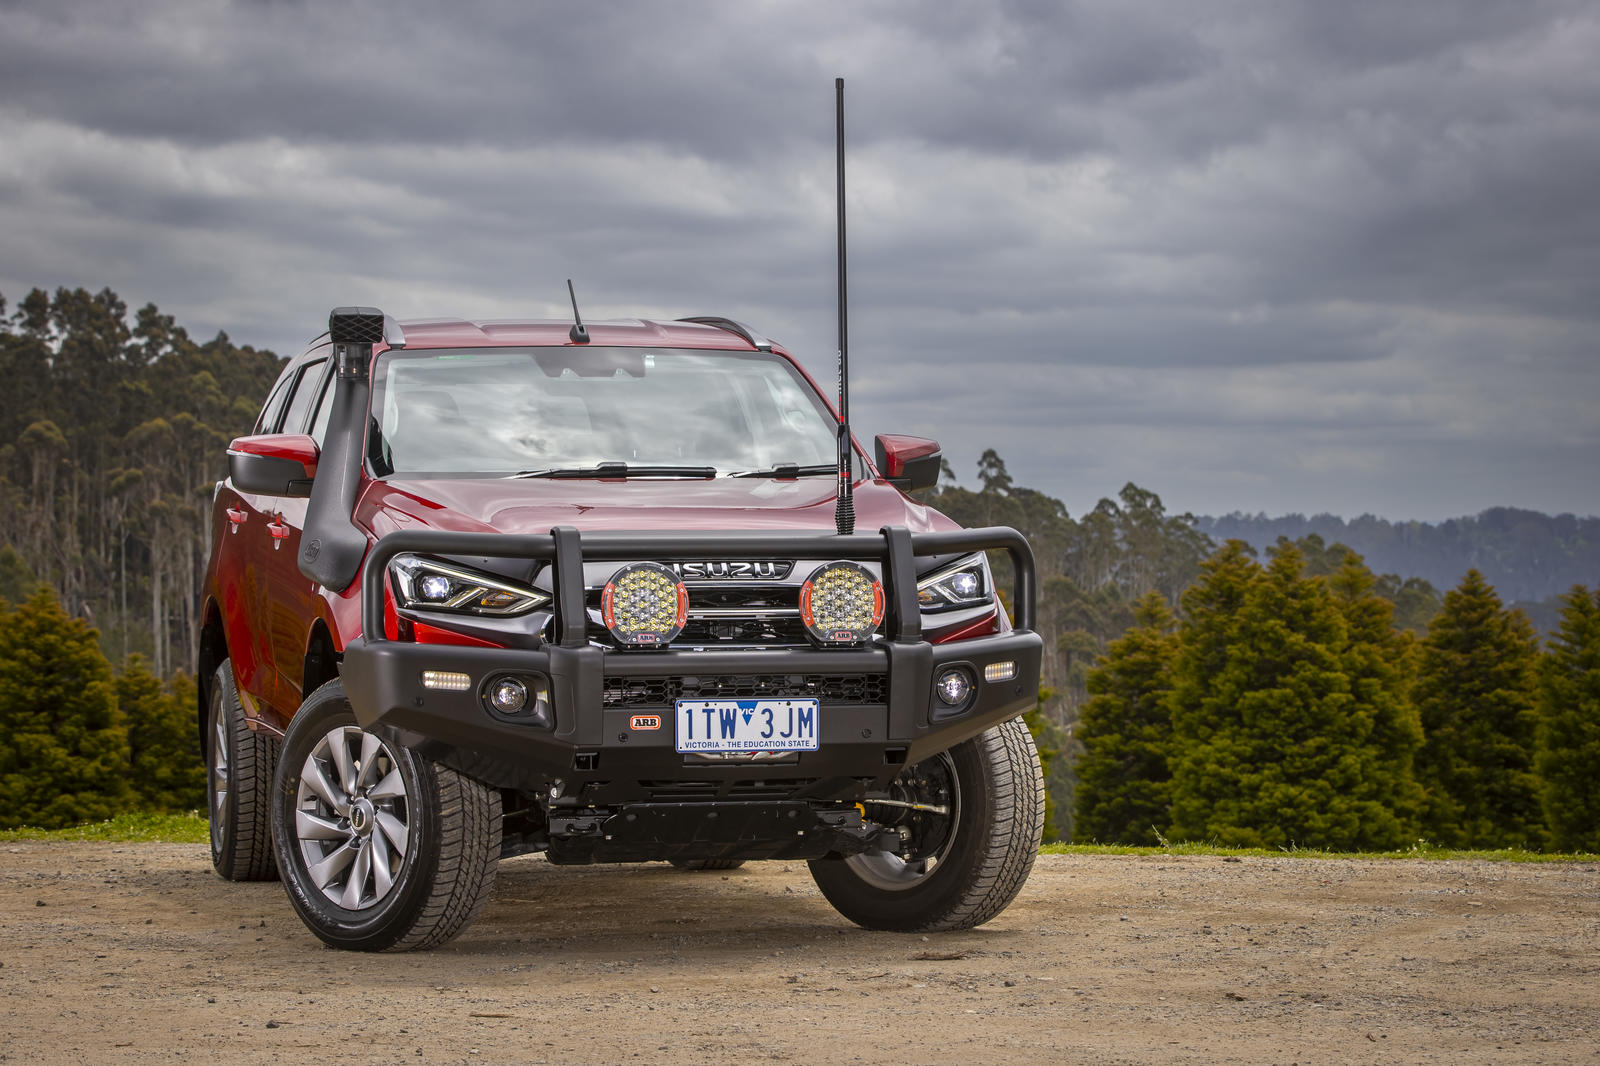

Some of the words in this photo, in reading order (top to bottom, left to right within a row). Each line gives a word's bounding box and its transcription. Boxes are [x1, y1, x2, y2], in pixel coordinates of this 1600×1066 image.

[672, 562, 776, 579] ISUZU
[634, 718, 657, 727] ARB
[685, 708, 737, 739] 1TW
[760, 707, 813, 739] 3JM
[743, 740, 786, 748] EDUCATION
